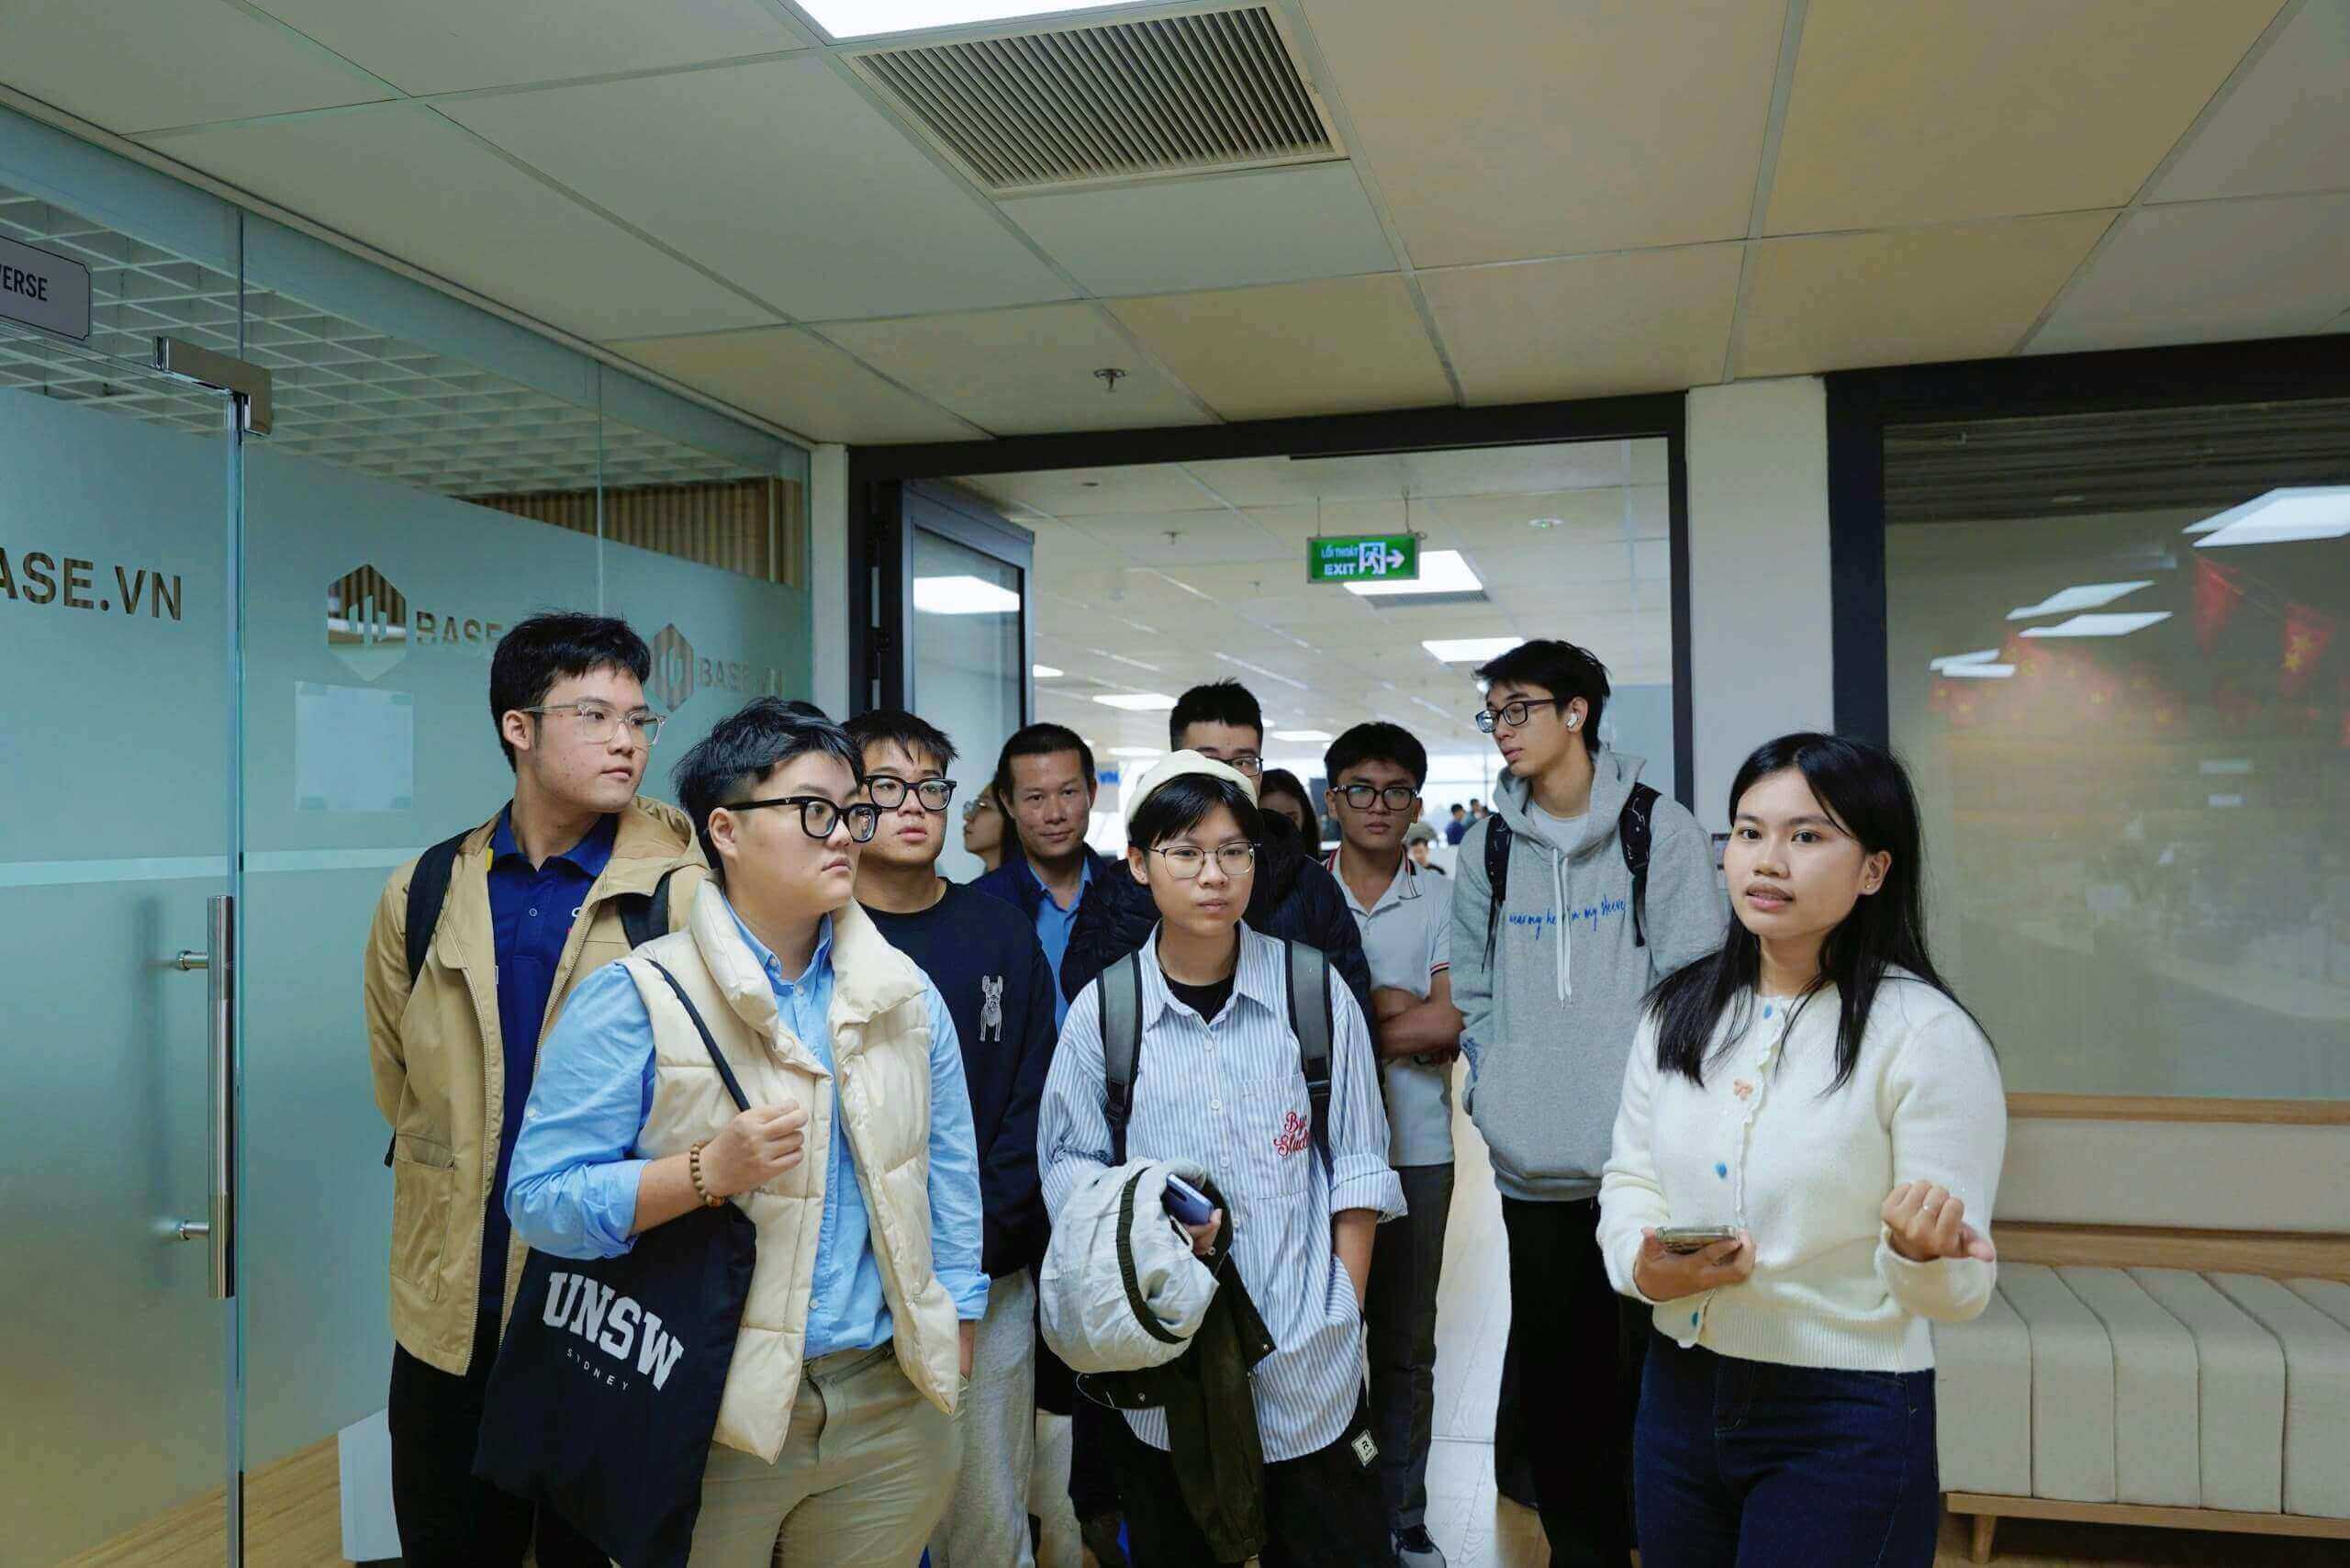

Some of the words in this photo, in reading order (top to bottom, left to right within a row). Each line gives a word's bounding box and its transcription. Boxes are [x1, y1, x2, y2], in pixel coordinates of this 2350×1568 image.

[0, 264, 48, 301] ERSE
[1325, 564, 1356, 575] EXIT
[543, 1271, 684, 1391] UNSW
[566, 1349, 629, 1390] SYDNEY
